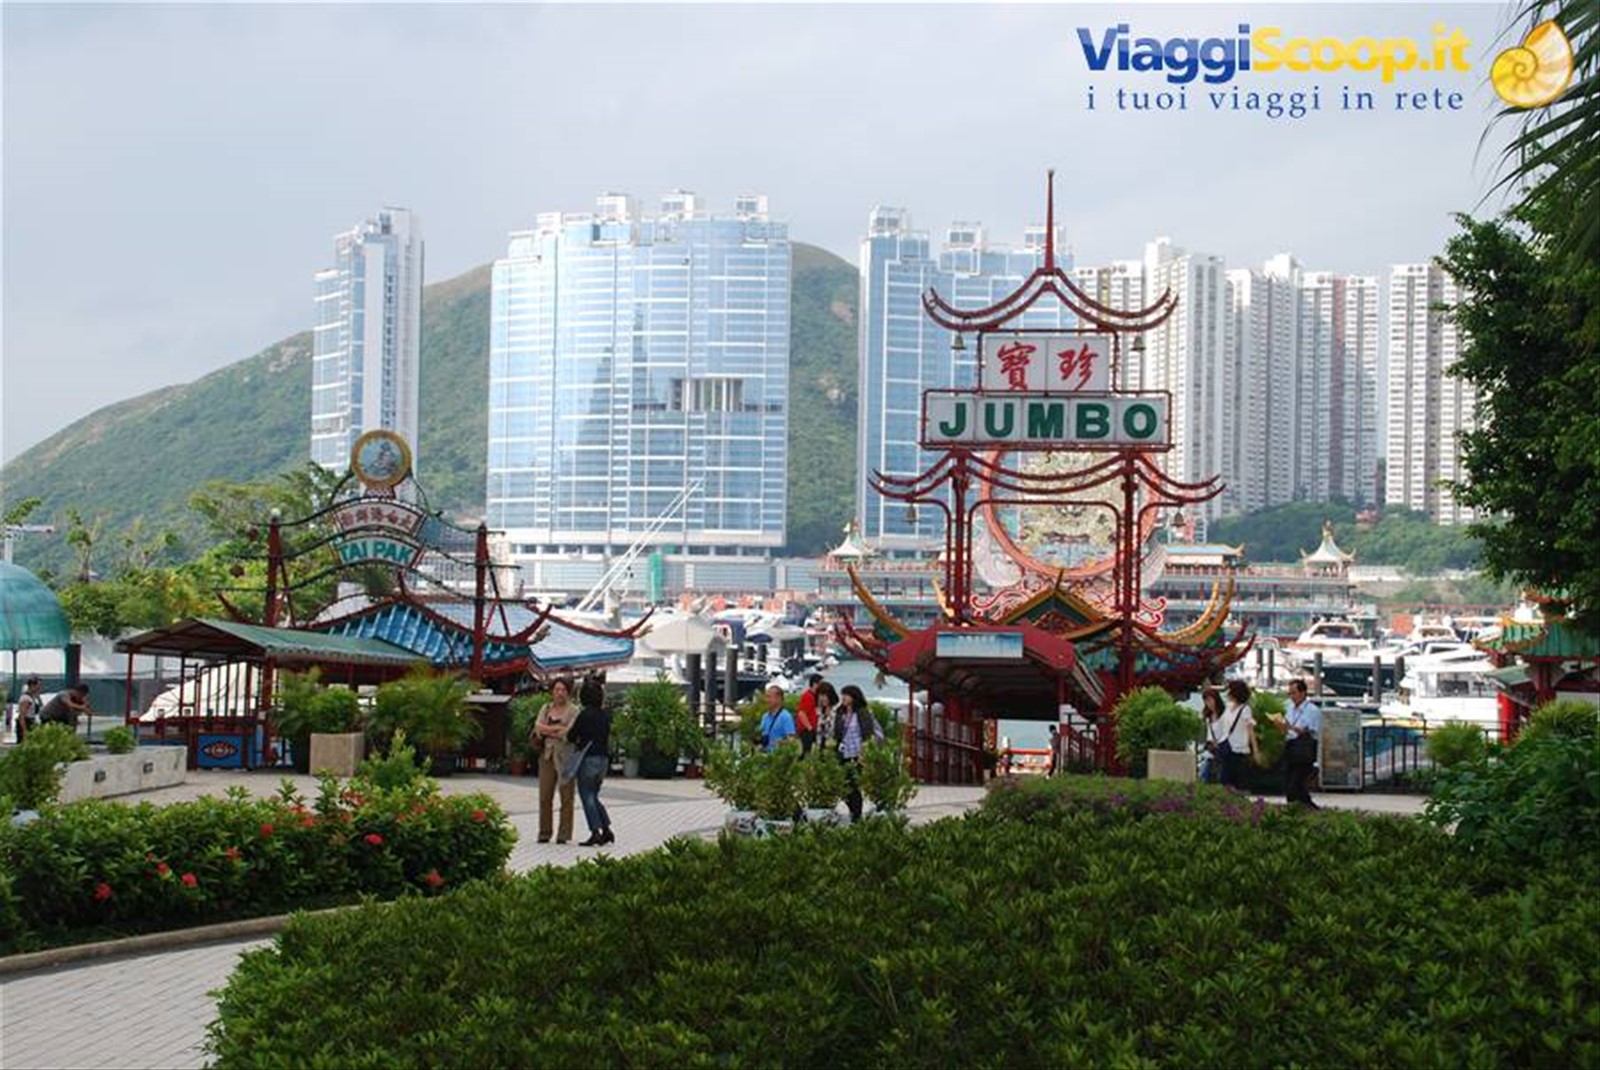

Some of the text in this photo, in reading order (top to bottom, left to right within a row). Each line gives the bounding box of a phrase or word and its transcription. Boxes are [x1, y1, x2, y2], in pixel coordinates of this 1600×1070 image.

[939, 402, 1158, 439] JUMBO
[339, 541, 413, 564] TAI PAK
